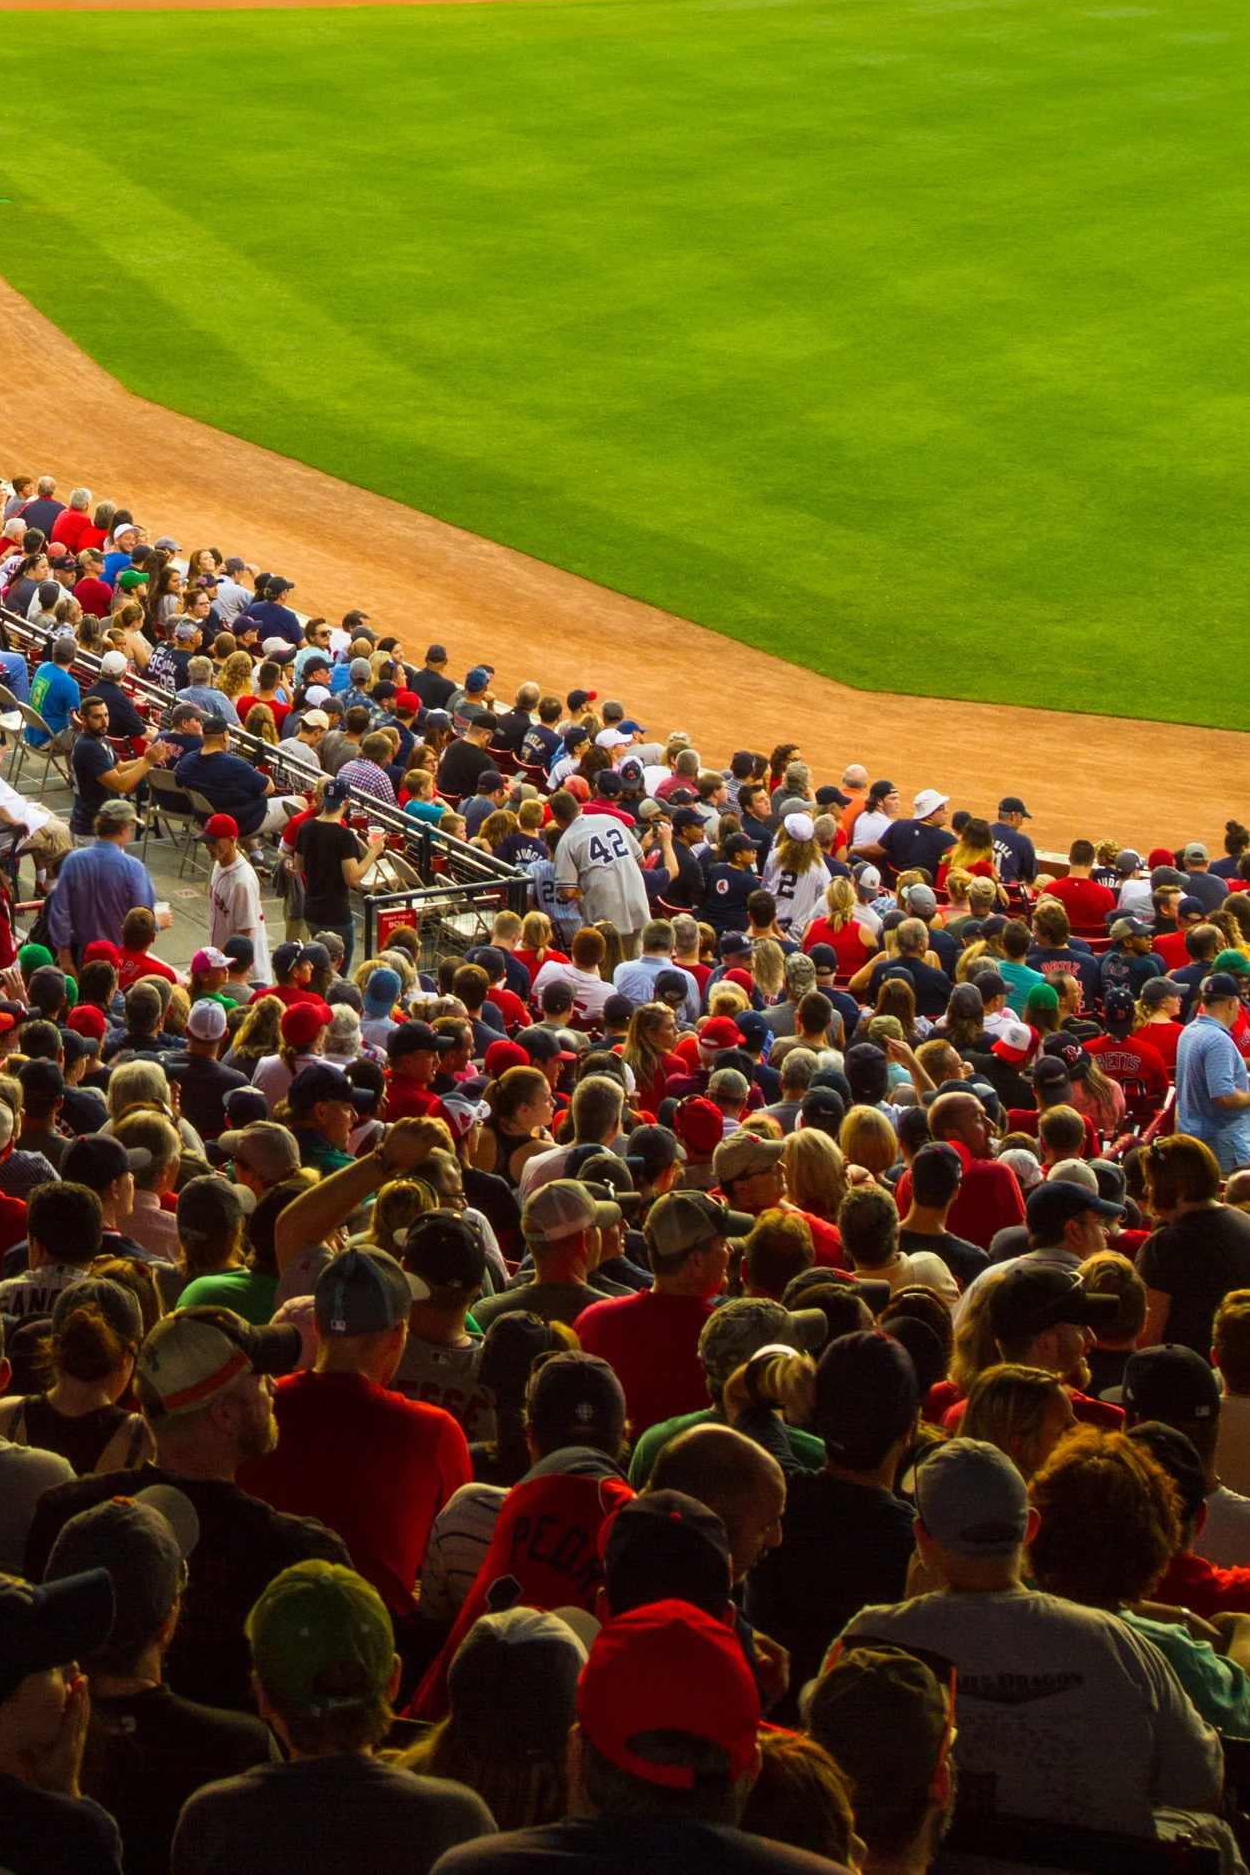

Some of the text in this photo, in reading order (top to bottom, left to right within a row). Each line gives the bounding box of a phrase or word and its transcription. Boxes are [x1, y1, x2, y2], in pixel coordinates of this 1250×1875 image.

[589, 828, 630, 865] 42
[776, 869, 798, 900] 2
[388, 920, 405, 928] BOX
[1041, 960, 1080, 976] ORTIZ
[1097, 1051, 1141, 1073] BETTS
